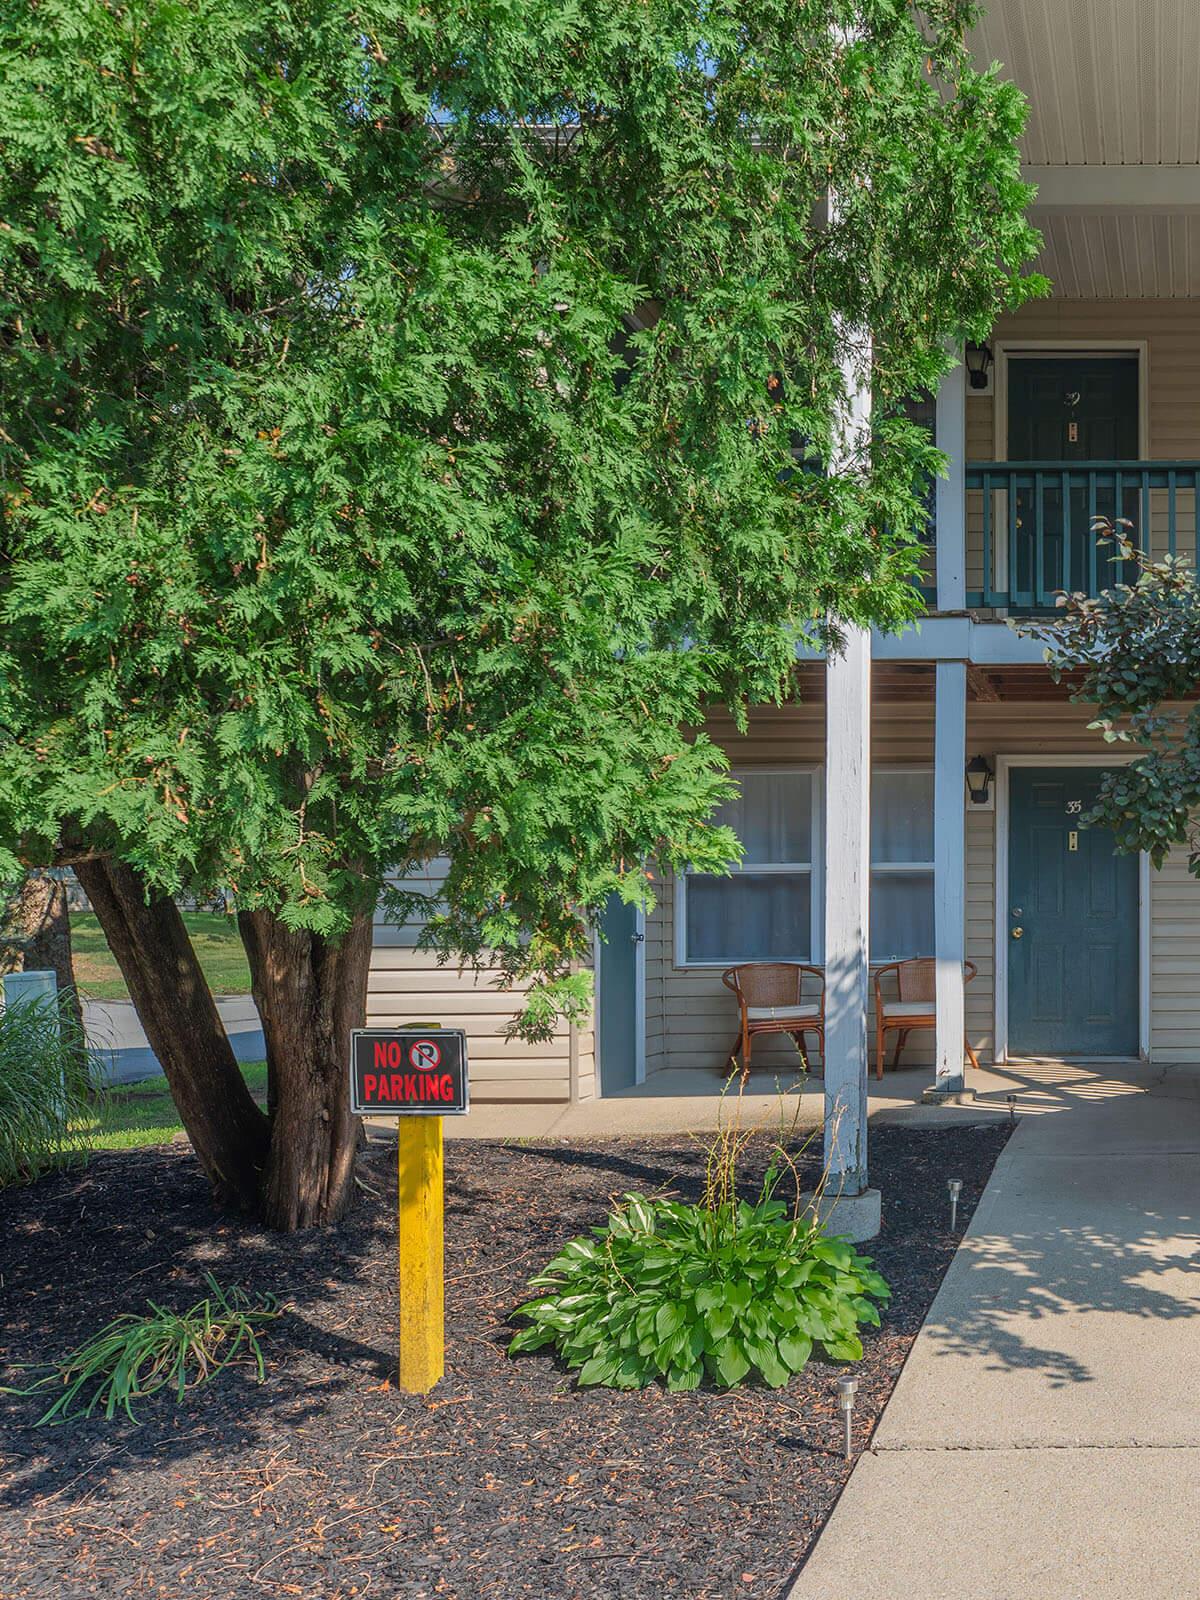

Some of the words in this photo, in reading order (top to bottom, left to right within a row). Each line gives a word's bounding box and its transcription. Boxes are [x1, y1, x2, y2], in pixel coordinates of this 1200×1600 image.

[1065, 800, 1081, 814] 35
[374, 1041, 401, 1068] NO
[364, 1073, 455, 1101] PARKING
